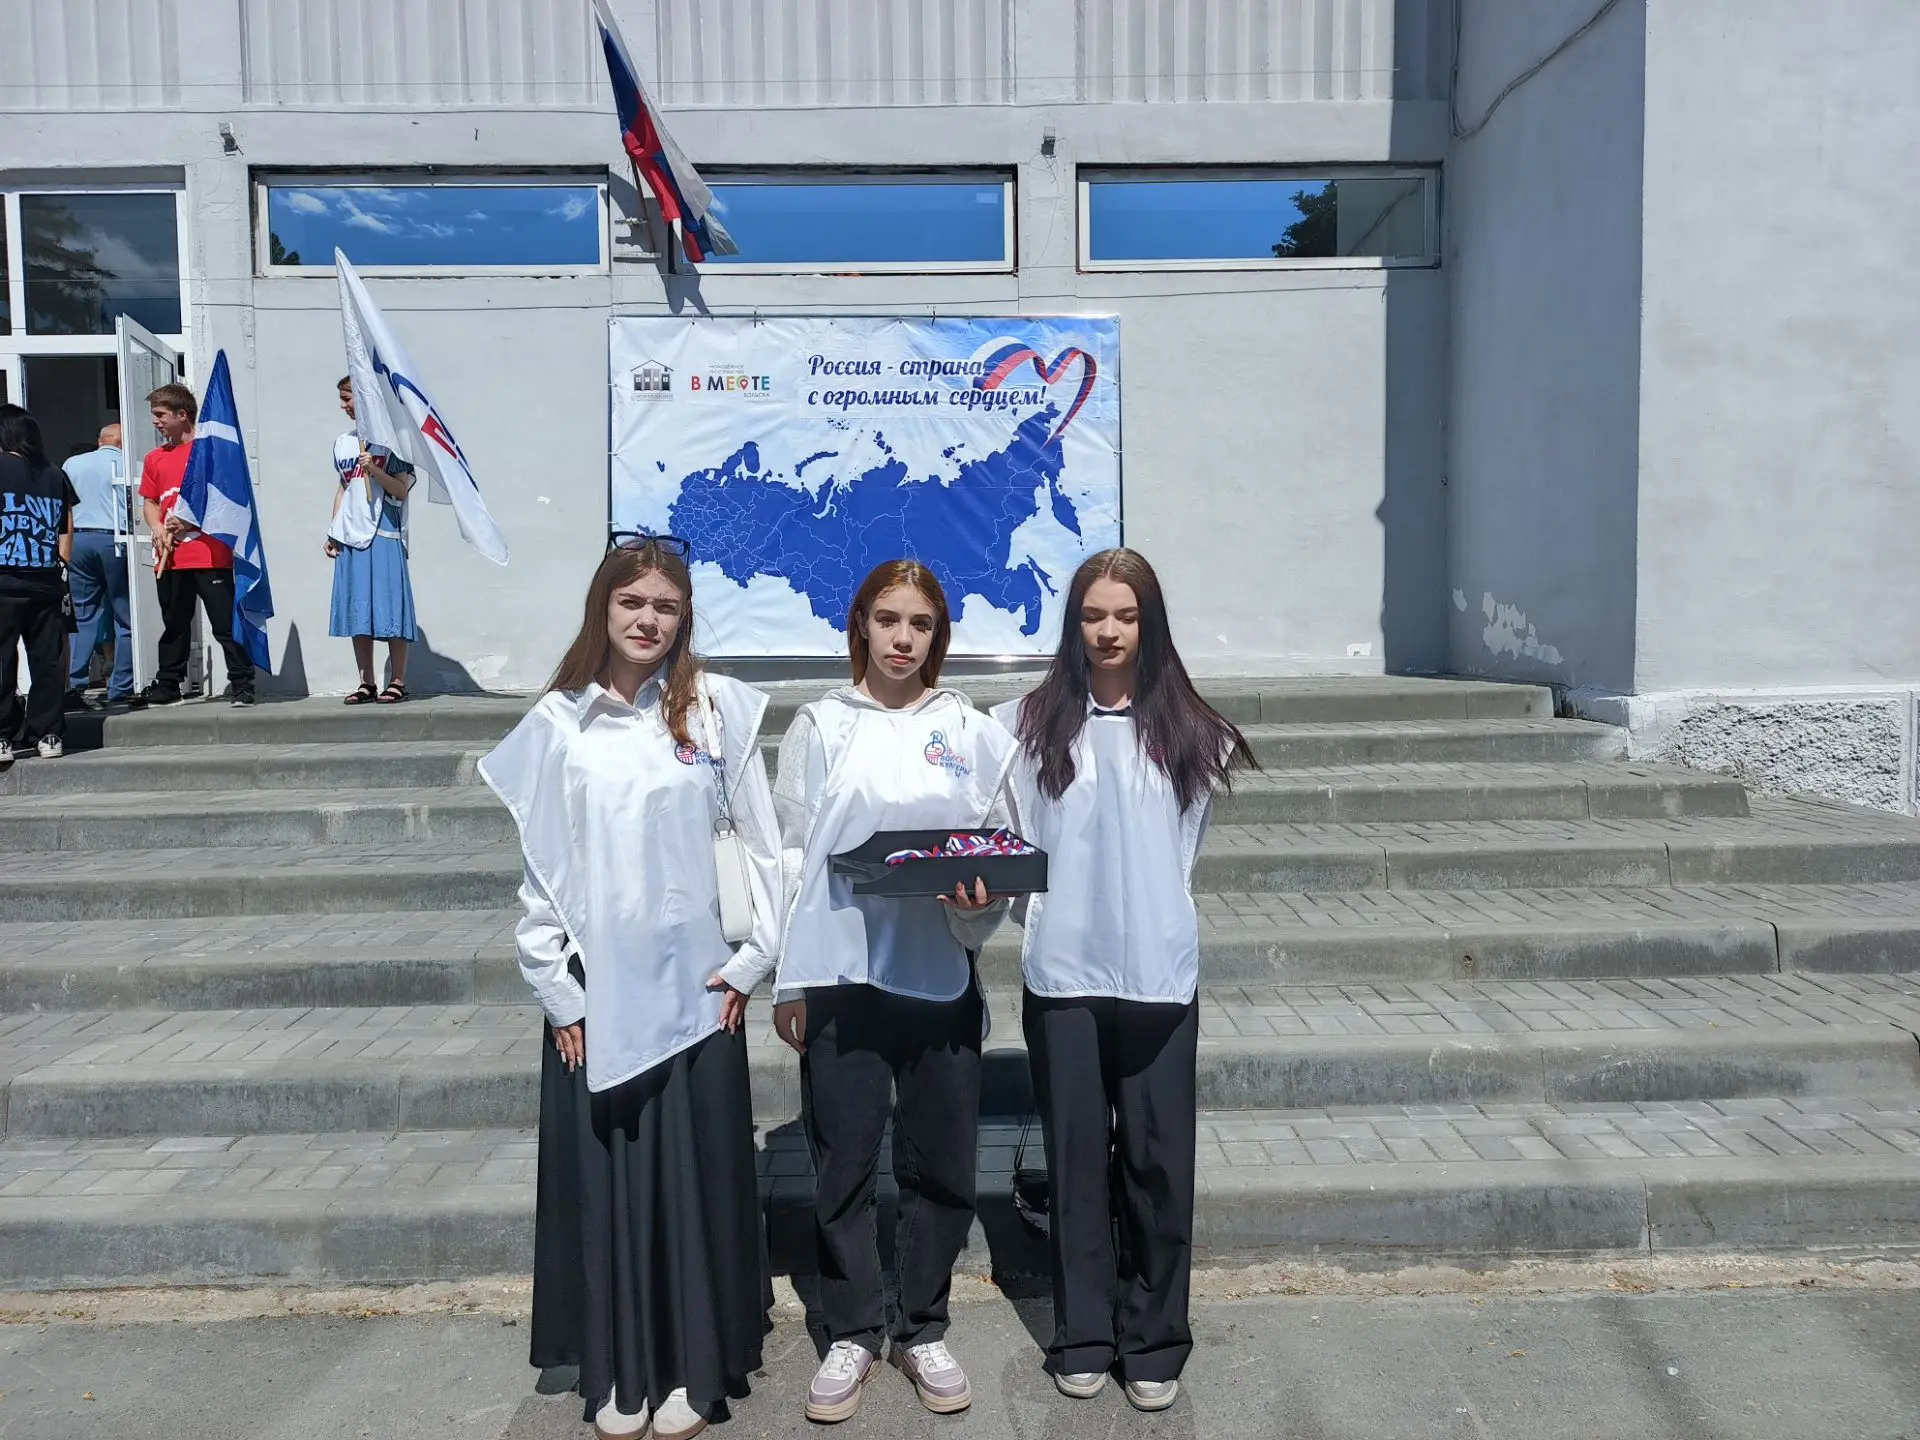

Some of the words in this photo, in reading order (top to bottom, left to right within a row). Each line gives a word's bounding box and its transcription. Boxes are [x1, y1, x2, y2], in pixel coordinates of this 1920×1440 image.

[808, 354, 882, 376] Россия
[899, 359, 983, 382] страна
[691, 375, 702, 391] В
[808, 390, 819, 405] с
[823, 390, 939, 412] огромным
[949, 386, 1047, 412] сердцем!
[3, 492, 63, 528] LOVE
